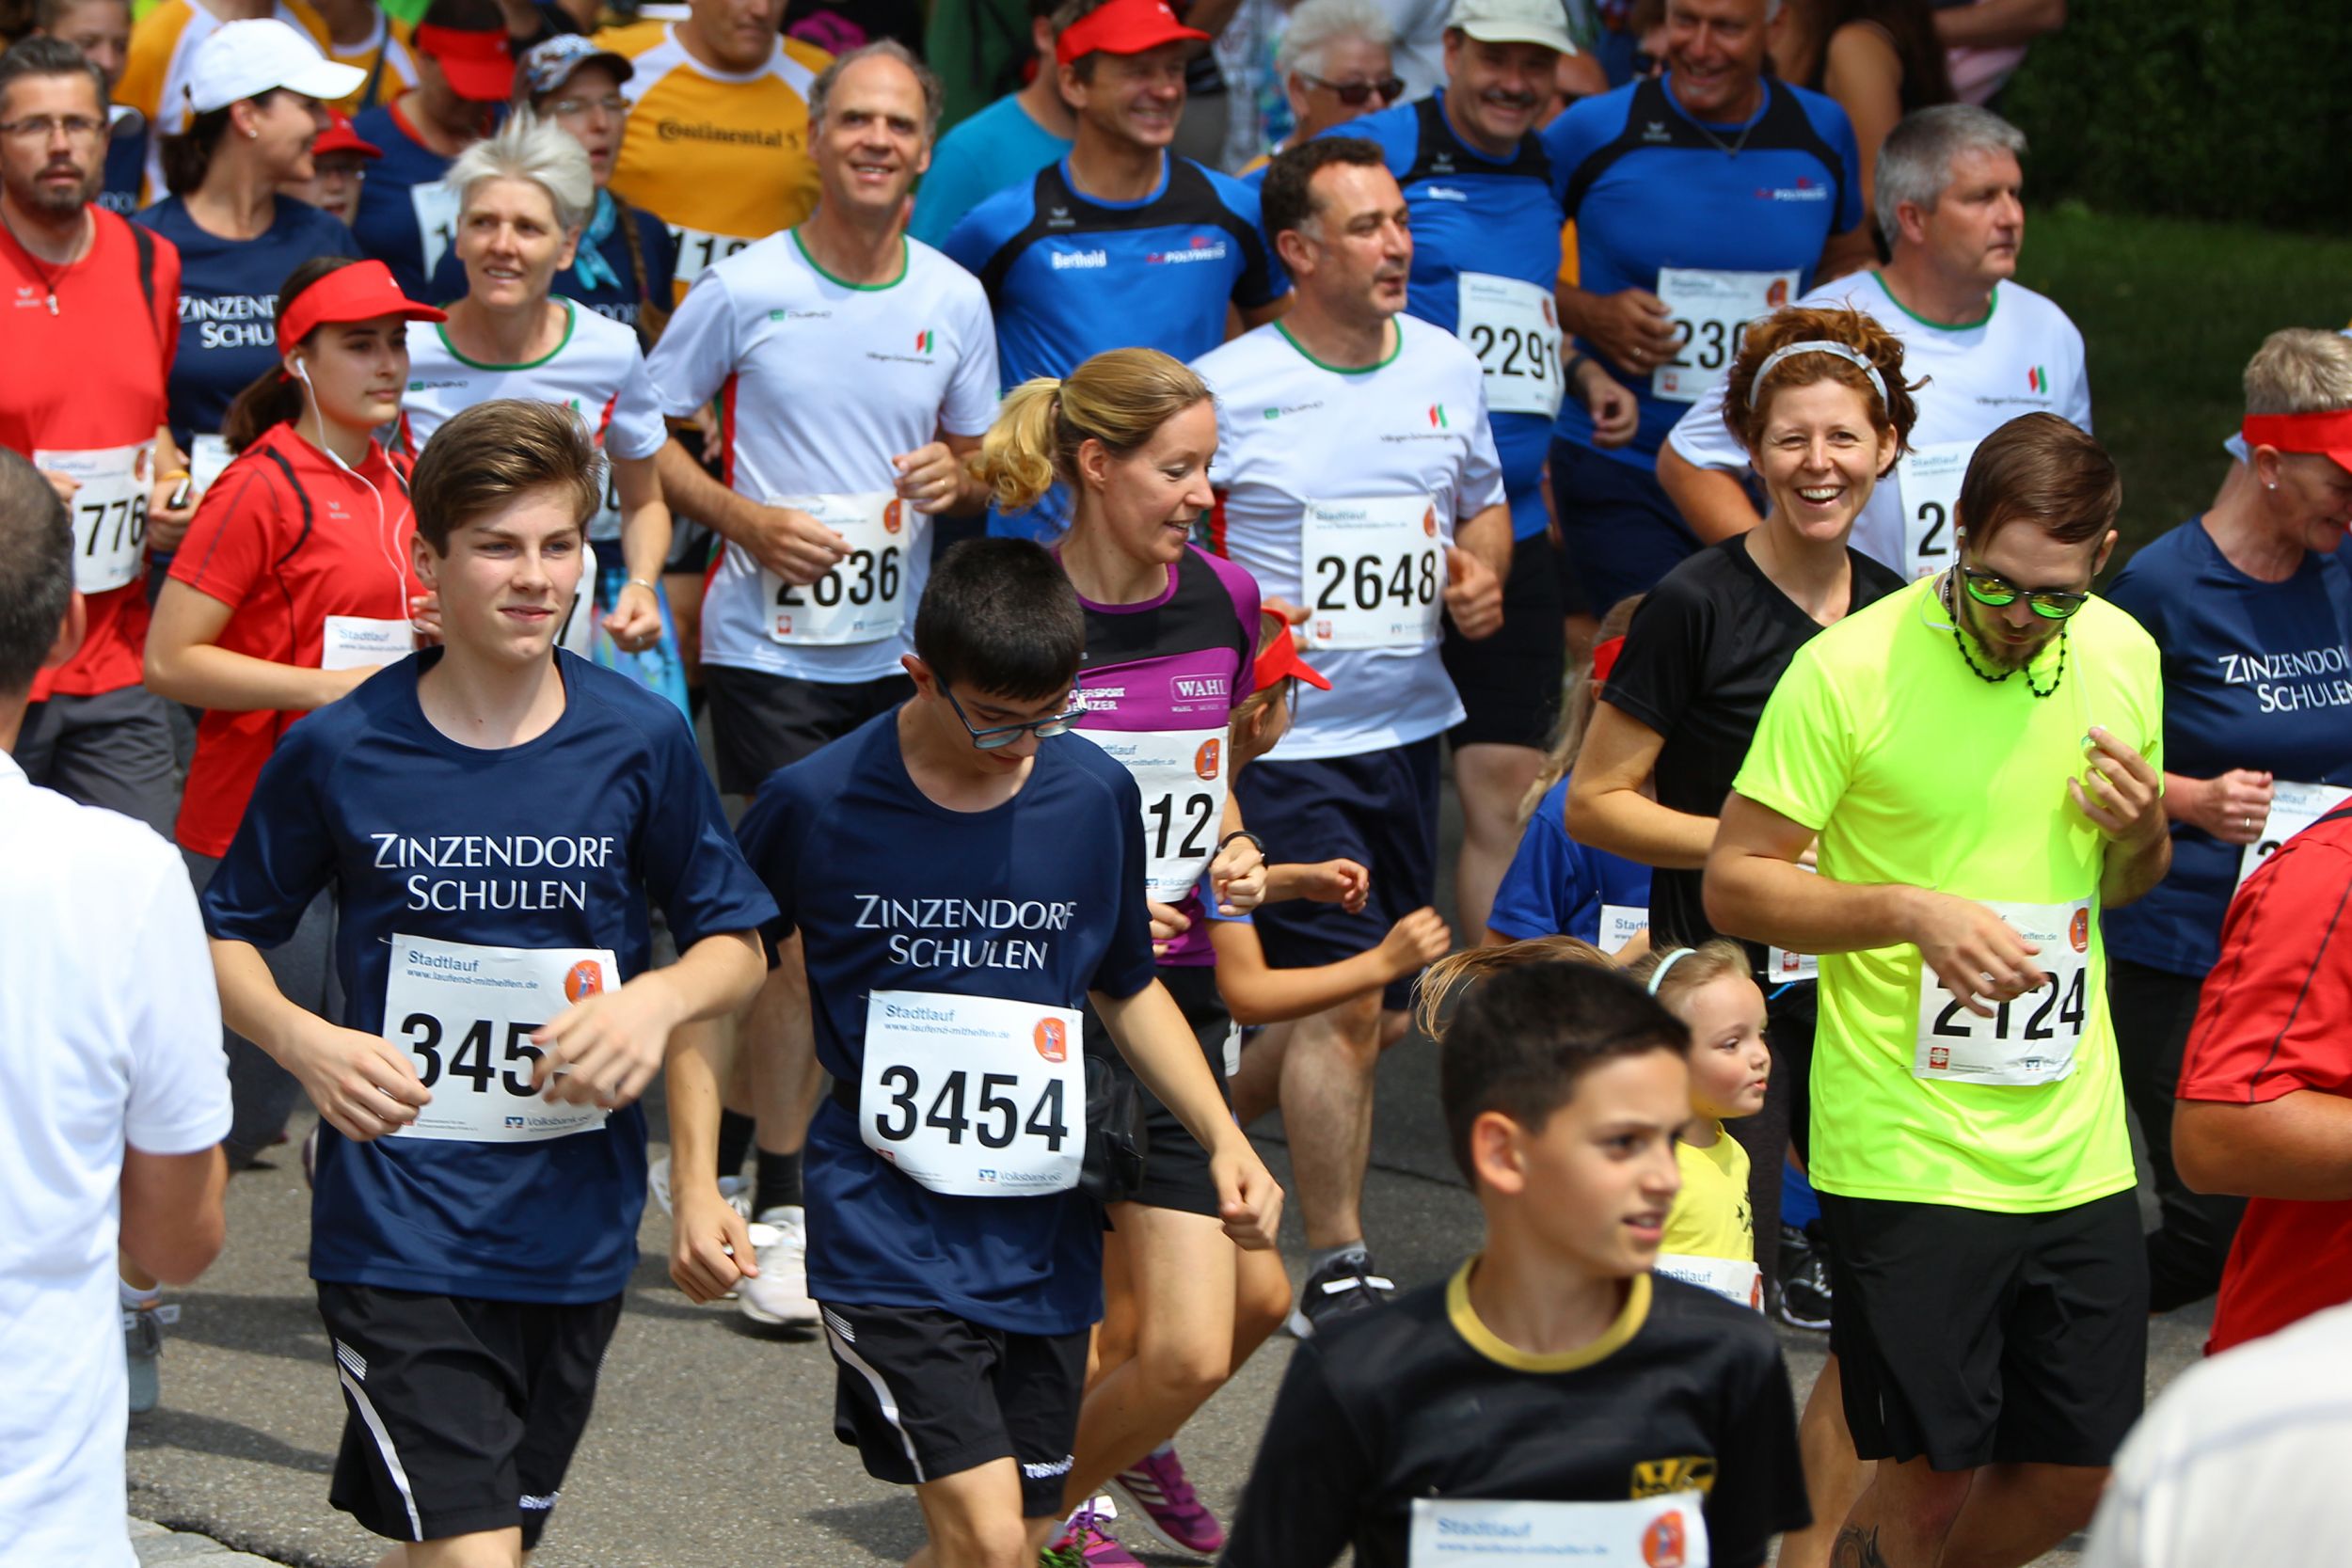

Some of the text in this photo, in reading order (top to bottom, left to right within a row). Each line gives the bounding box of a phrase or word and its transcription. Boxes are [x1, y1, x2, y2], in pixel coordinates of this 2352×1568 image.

[658, 119, 783, 148] Continental
[1470, 325, 1560, 386] 2291
[1316, 549, 1437, 610] 2648
[1149, 793, 1214, 859] 12
[371, 832, 614, 868] ZINZENDORF
[407, 874, 586, 911] SCHULEN
[854, 894, 1078, 931] ZINZENDORF
[408, 949, 480, 973] Stadtlauf
[888, 933, 1049, 971] SCHULEN
[406, 968, 540, 990] www.laufend-mithelfen.de
[884, 1004, 956, 1022] Stadtlauf
[400, 1012, 568, 1098] 345
[875, 1064, 1069, 1153] 3454
